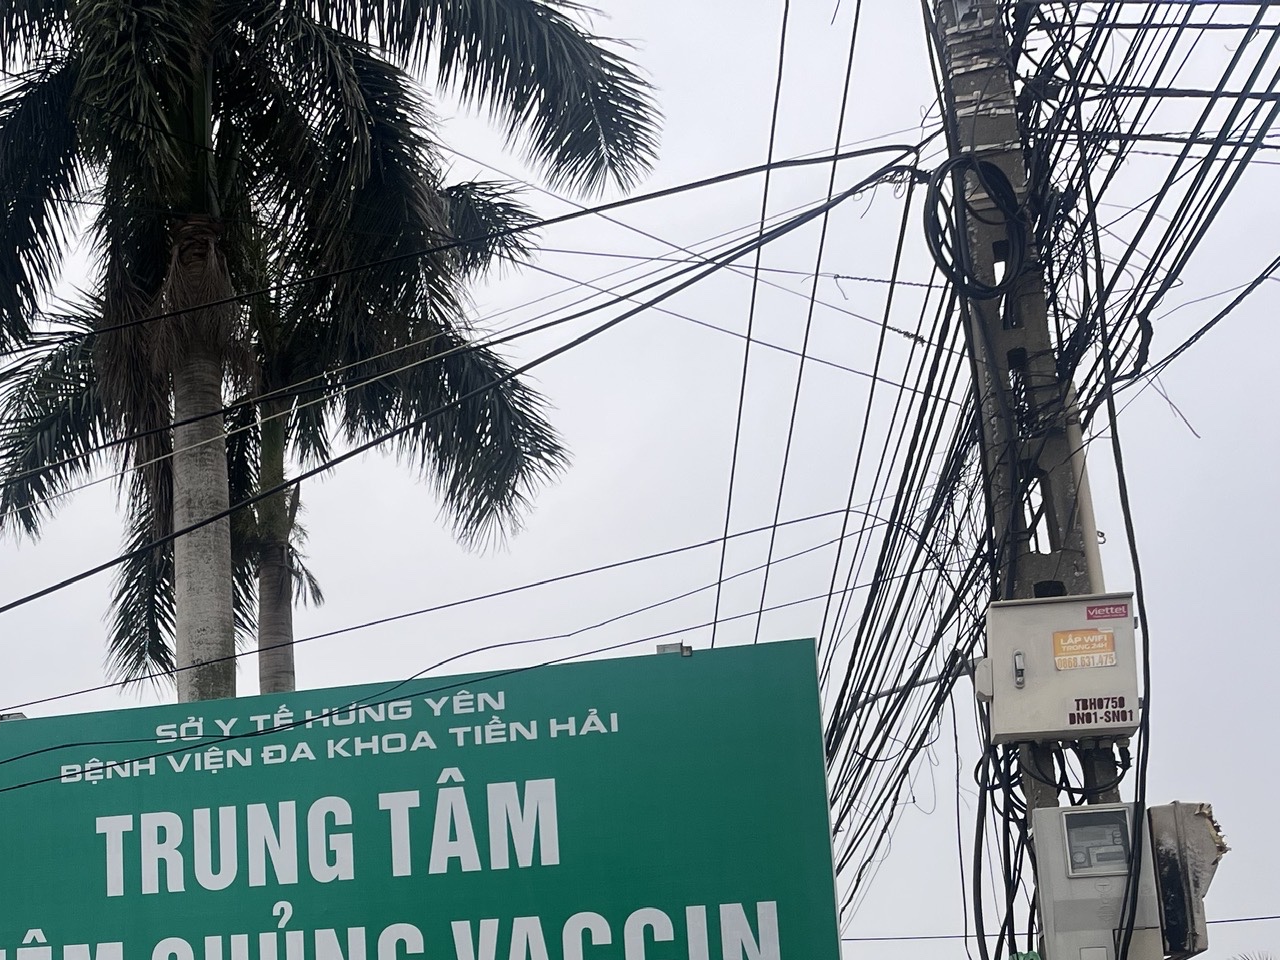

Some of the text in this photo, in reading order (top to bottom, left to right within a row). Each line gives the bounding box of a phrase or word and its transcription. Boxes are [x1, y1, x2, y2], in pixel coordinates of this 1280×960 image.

[1087, 605, 1127, 617] viettel
[1084, 635, 1107, 643] WIFI
[1074, 696, 1125, 711] TBH0750
[155, 690, 505, 744] SỞ Y TẾ HƯNG YÊN
[1068, 710, 1133, 725] DN01-SN01
[60, 708, 619, 785] BỆNH VIỆN ĐA KHOA TIỀN HẢI
[95, 767, 560, 897] TRUNG TÂM
